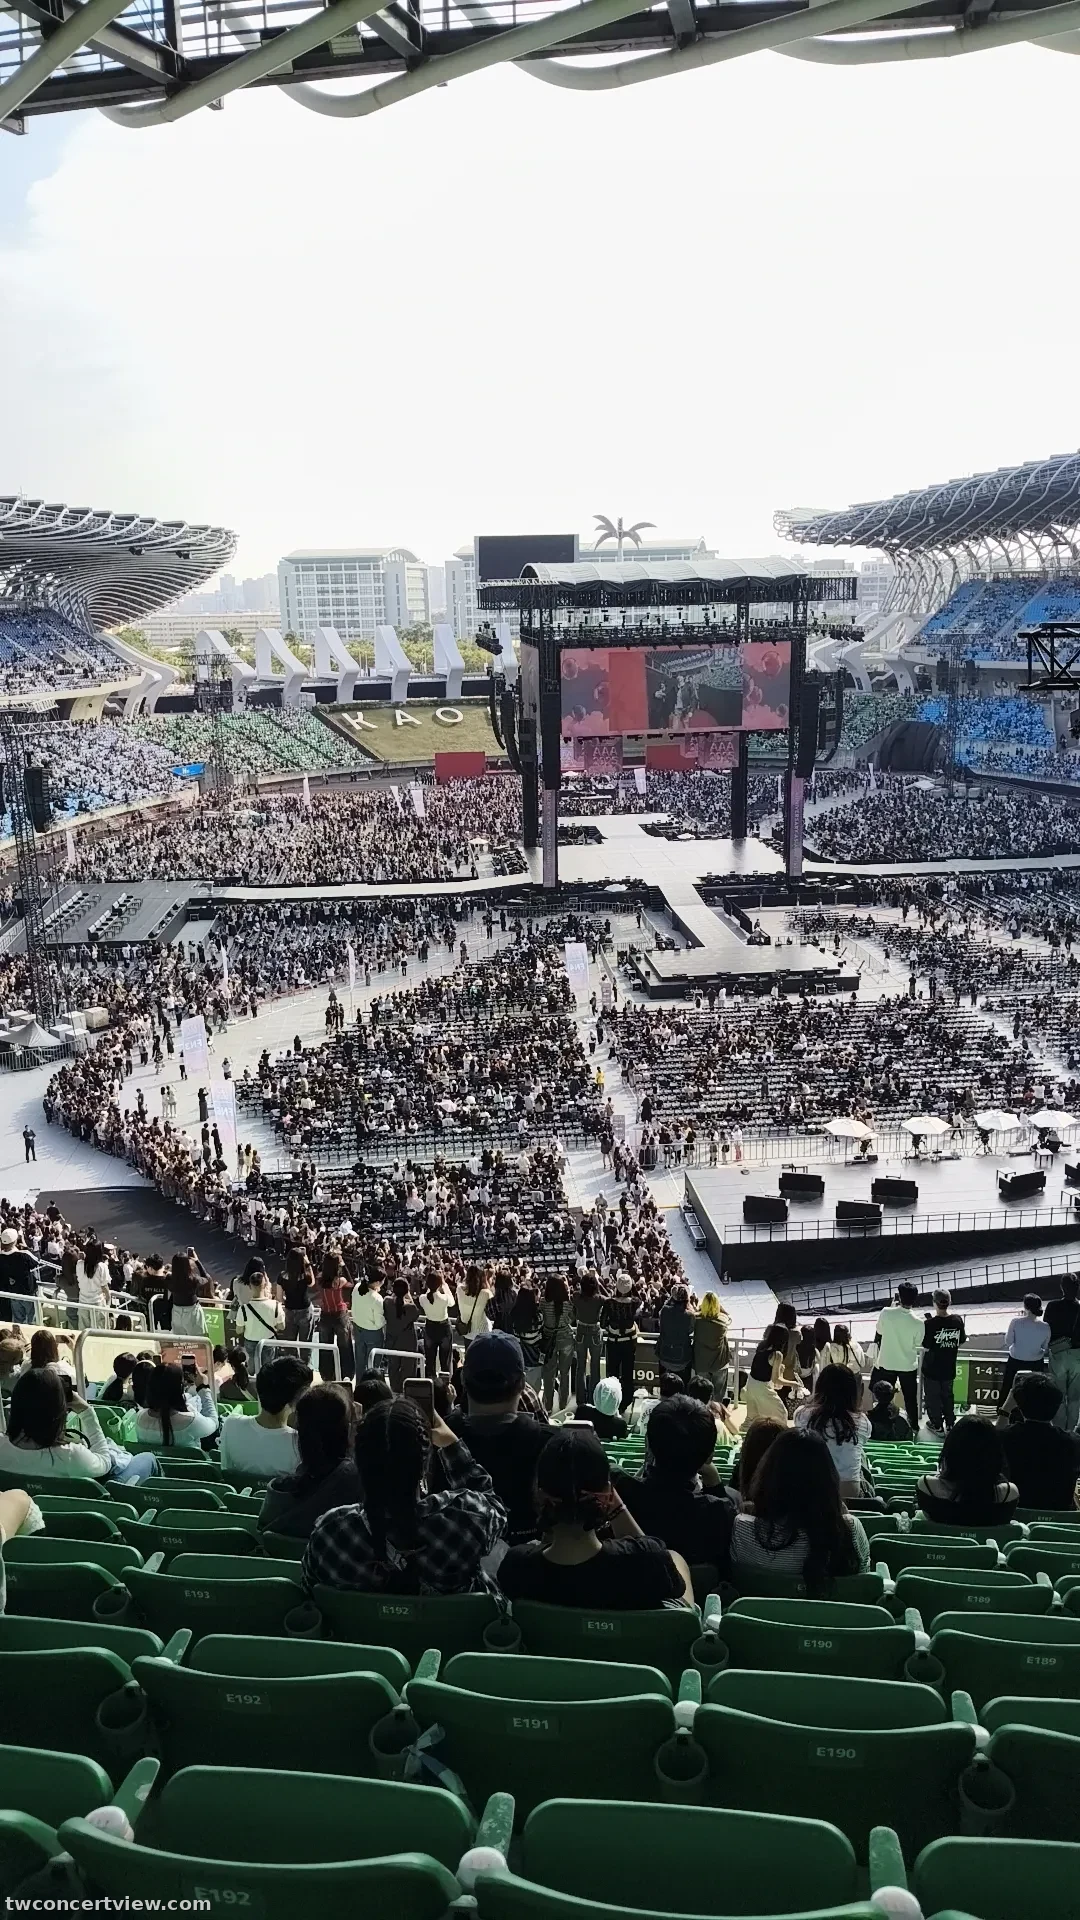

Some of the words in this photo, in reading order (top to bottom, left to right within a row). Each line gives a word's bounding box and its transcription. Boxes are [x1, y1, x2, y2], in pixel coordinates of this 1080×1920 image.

[592, 746, 617, 757] AAA
[710, 741, 734, 751] AAA
[205, 1313, 219, 1324] 27
[975, 1367, 993, 1375] 1-4
[184, 1589, 211, 1600] E193
[967, 1595, 991, 1604] E189
[382, 1605, 410, 1616] E192
[587, 1621, 615, 1632] E191
[803, 1639, 833, 1650] E190
[1026, 1655, 1057, 1666] E189
[226, 1693, 262, 1706] E192
[512, 1717, 549, 1730] E191
[816, 1746, 857, 1760] E190
[194, 1887, 252, 1906] E192
